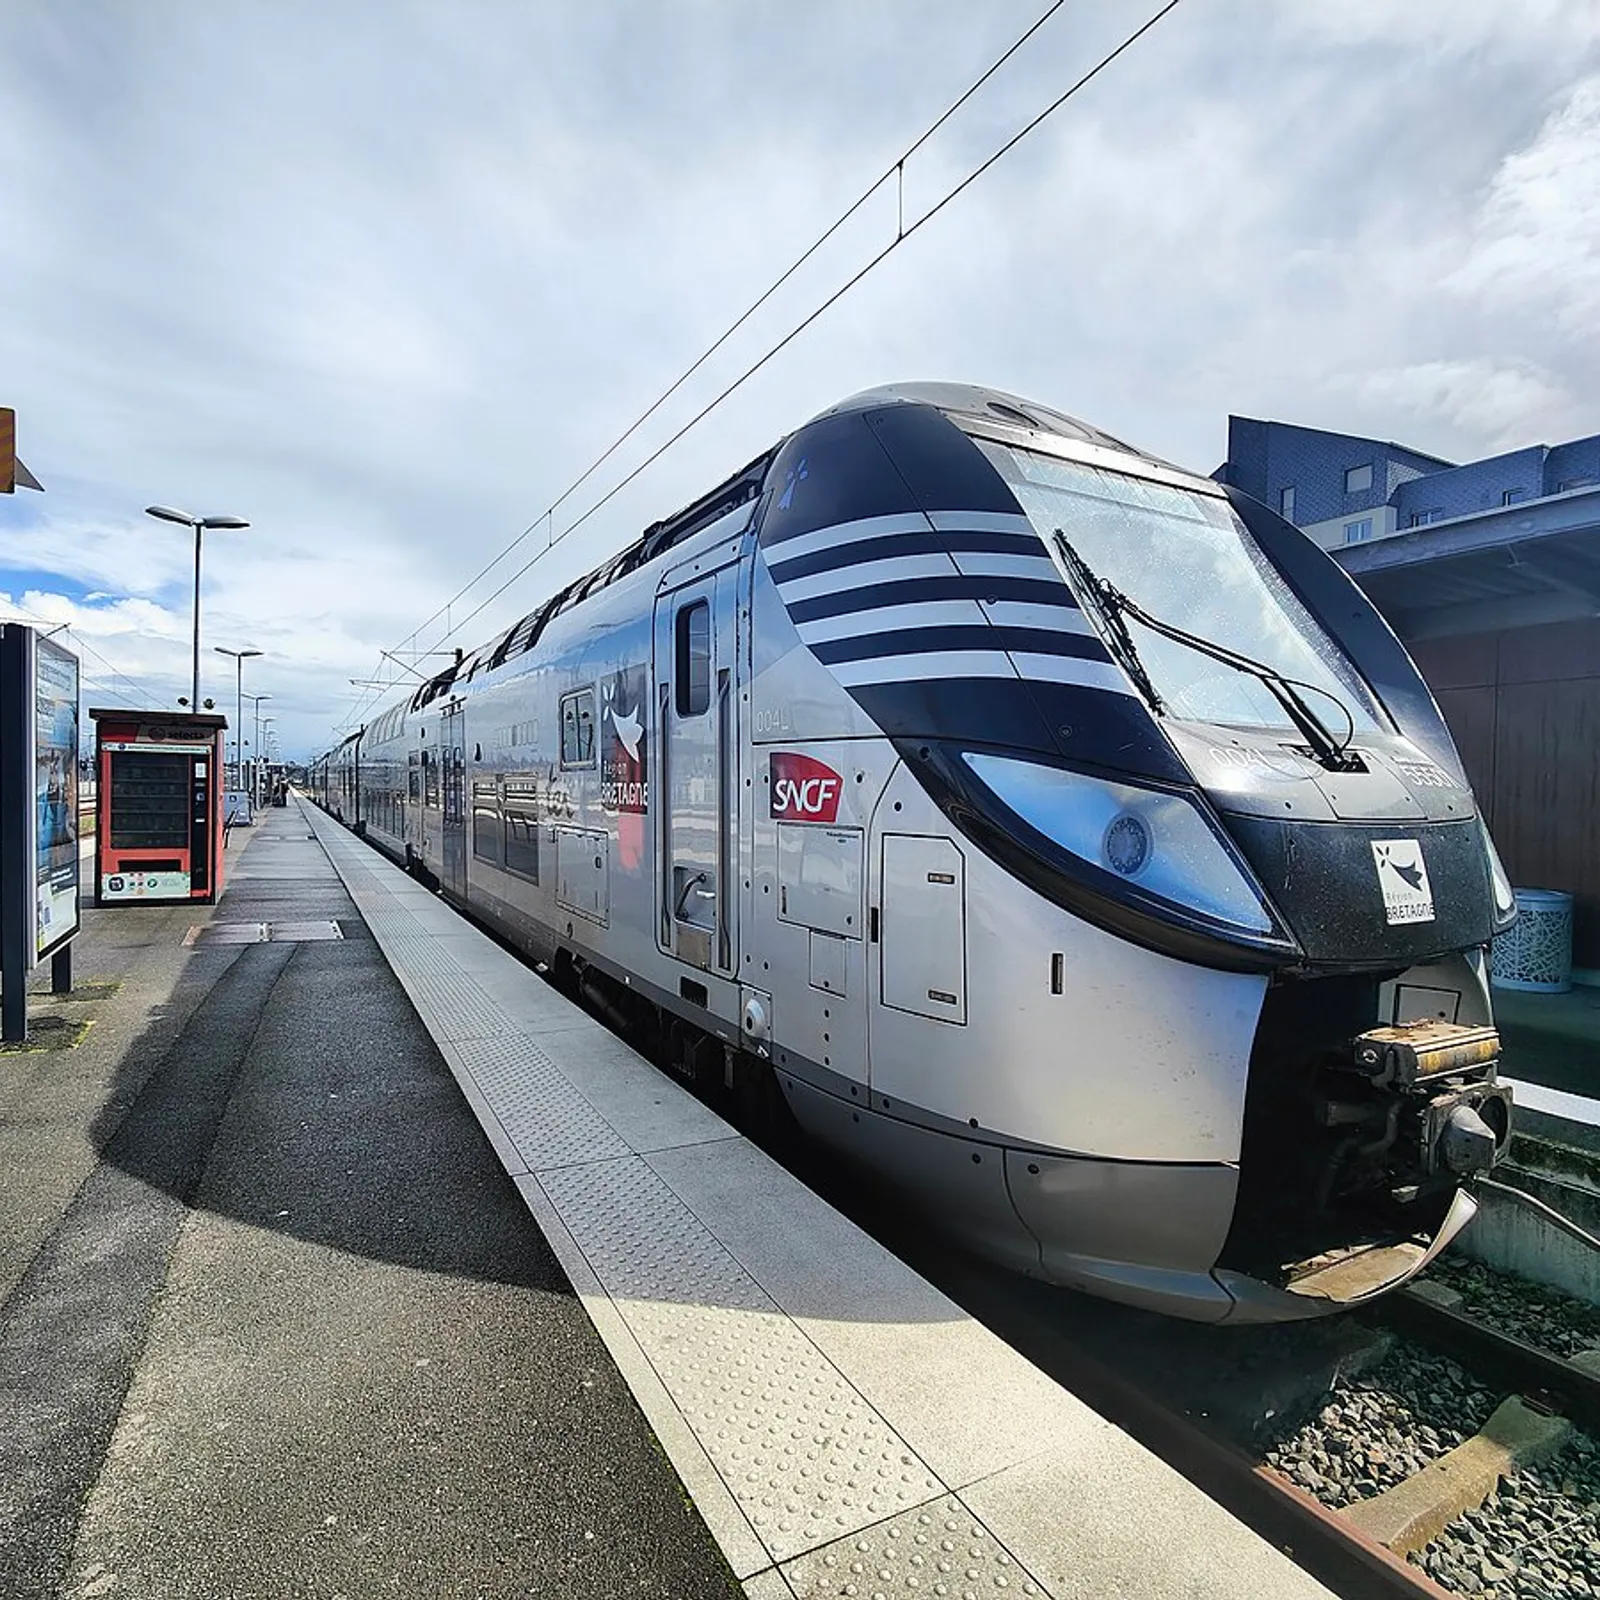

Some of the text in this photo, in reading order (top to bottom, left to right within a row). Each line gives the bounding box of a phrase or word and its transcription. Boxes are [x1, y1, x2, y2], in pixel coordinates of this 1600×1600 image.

[602, 781, 648, 807] BRETAGNE
[773, 778, 837, 813] SNCF
[1386, 902, 1436, 920] BRETAGNE
